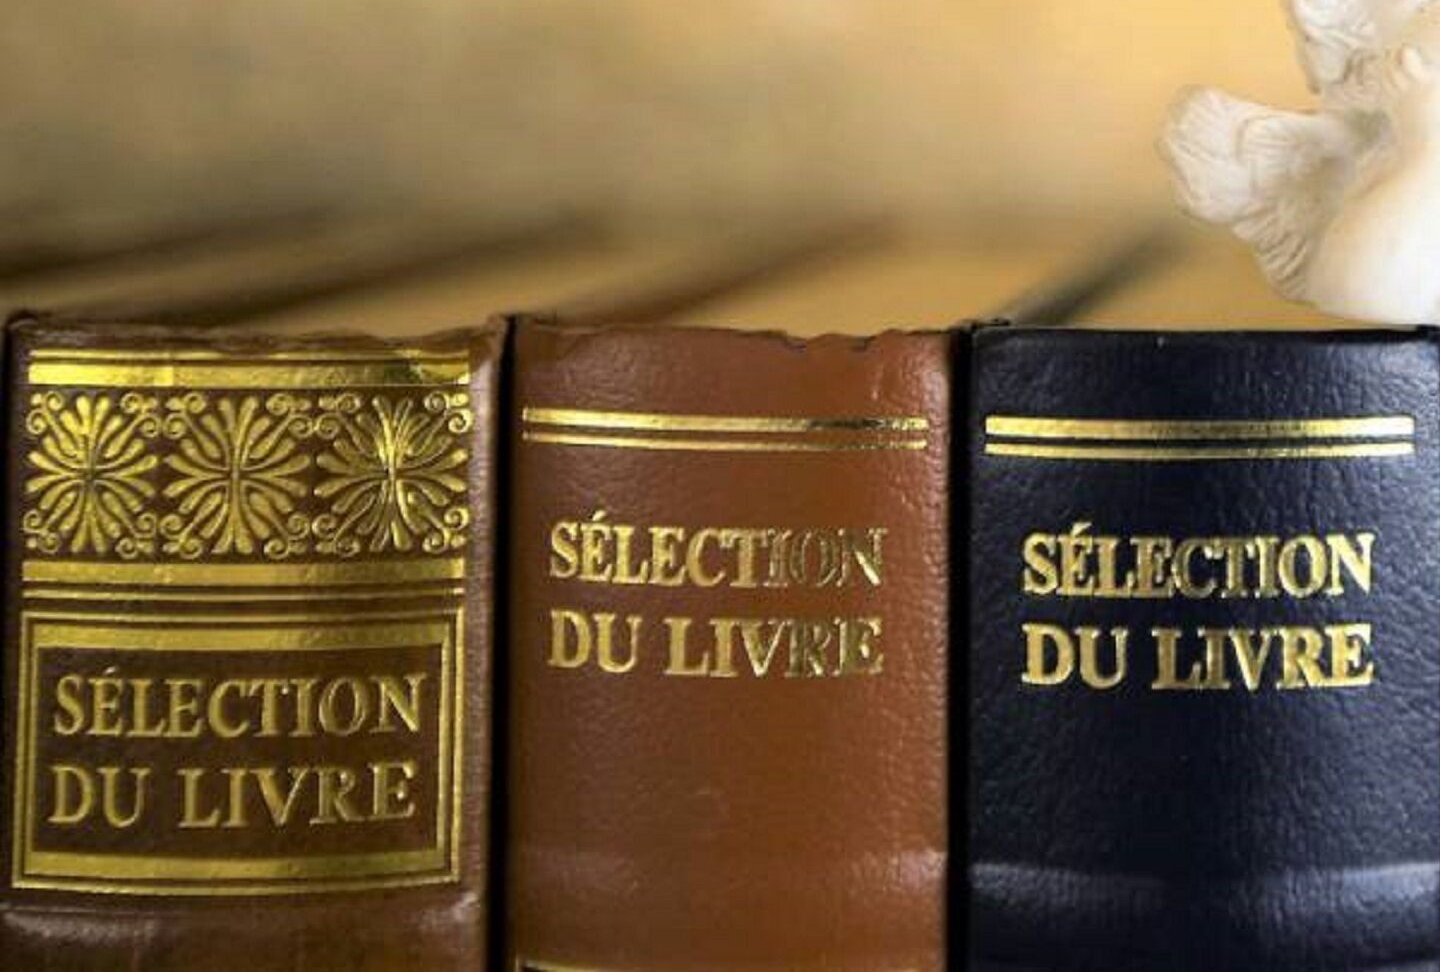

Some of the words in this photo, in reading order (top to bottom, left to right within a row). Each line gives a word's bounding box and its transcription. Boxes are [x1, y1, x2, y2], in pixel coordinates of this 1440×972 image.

[549, 510, 888, 589] SÉLECTION
[1022, 522, 1375, 599] SÉLECTION
[548, 609, 641, 674] DU
[663, 616, 884, 679] LIVRE
[1022, 624, 1128, 688] DU
[1151, 623, 1375, 691] LIVRE
[55, 668, 427, 737] SÉLECTION
[48, 764, 150, 827] DU
[178, 760, 415, 827] LIVRE
